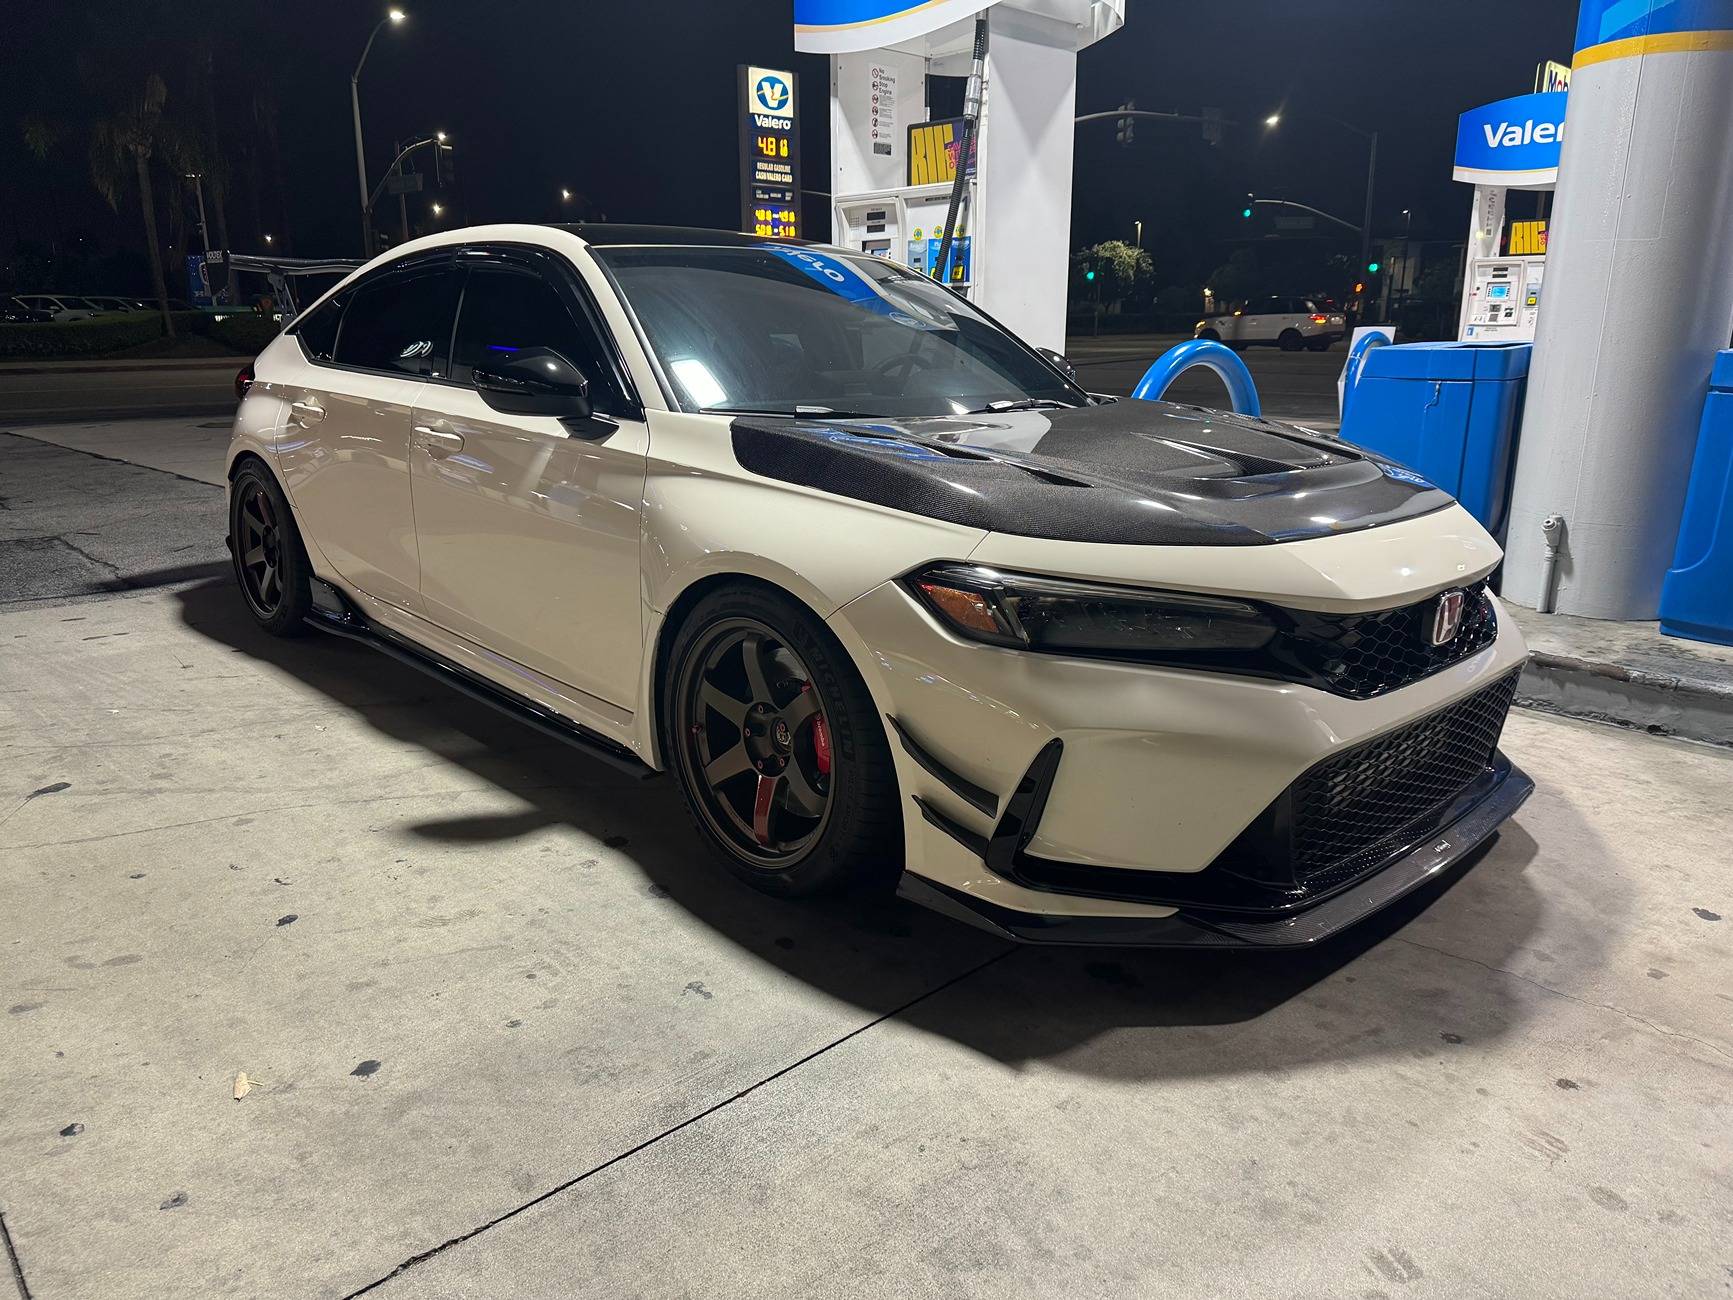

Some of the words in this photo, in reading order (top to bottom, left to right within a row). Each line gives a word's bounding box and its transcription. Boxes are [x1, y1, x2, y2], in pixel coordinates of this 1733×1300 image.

[754, 114, 792, 130] Valero
[756, 161, 774, 171] REGULAR
[773, 163, 791, 173] GASOLINE
[755, 171, 767, 180] CASH
[766, 172, 782, 182] VALERO
[781, 173, 793, 183] CARD
